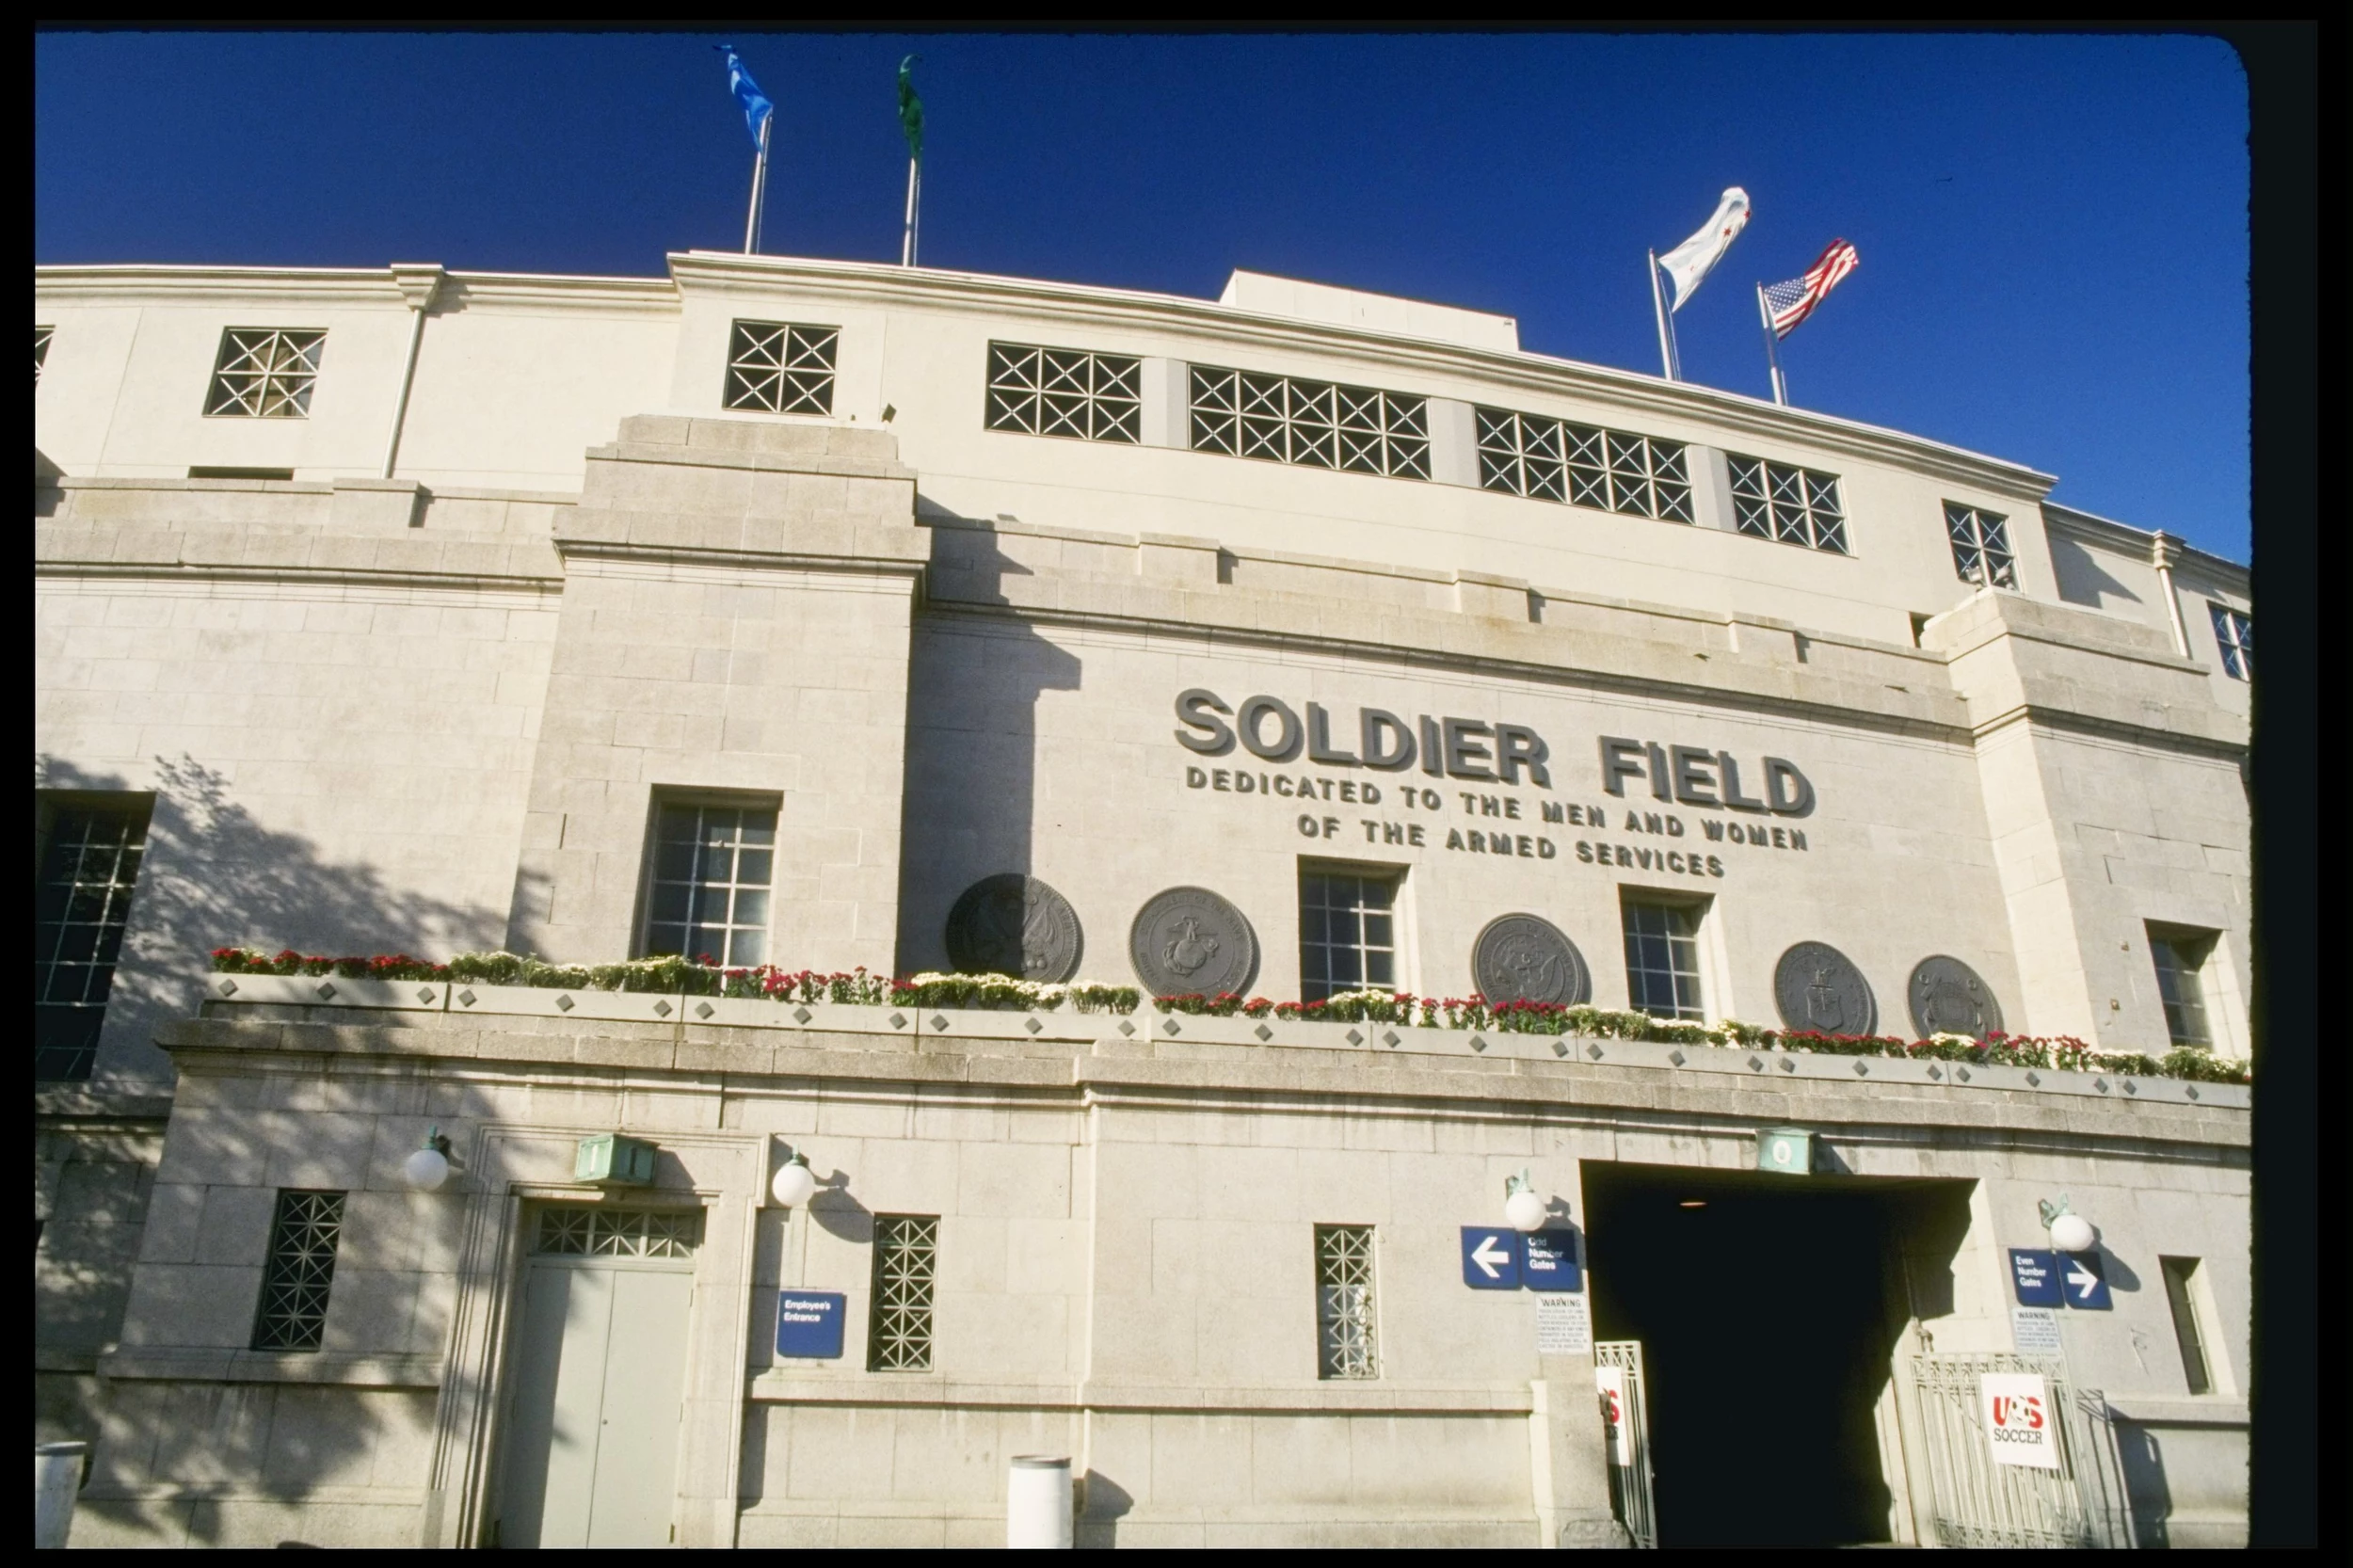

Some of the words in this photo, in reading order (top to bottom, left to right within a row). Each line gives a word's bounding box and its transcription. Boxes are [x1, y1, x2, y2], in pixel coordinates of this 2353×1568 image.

[1175, 688, 1549, 785] SOLDIER
[1598, 735, 1815, 815] FIELD
[1186, 765, 1382, 805] DEDICATED
[1401, 785, 1441, 811] TO
[1459, 792, 1521, 820] THE
[1542, 801, 1606, 829] MEN
[1625, 809, 1685, 839] AND
[1701, 817, 1809, 852] WOMEN
[1297, 813, 1340, 840] OF
[1361, 820, 1426, 847] THE
[1446, 828, 1556, 860] ARMED
[1576, 840, 1724, 879] SERVICES
[1529, 1248, 1563, 1258] Number
[1529, 1259, 1556, 1271] Gates
[2015, 1256, 2035, 1265] Even
[2017, 1267, 2047, 1276] Number
[2019, 1277, 2042, 1288] Gates
[785, 1300, 831, 1311] Employee's
[1541, 1297, 1581, 1307] WARNING
[784, 1312, 821, 1322] Entrance
[2017, 1312, 2051, 1320] WARNING
[1993, 1428, 2042, 1444] SOCCER
